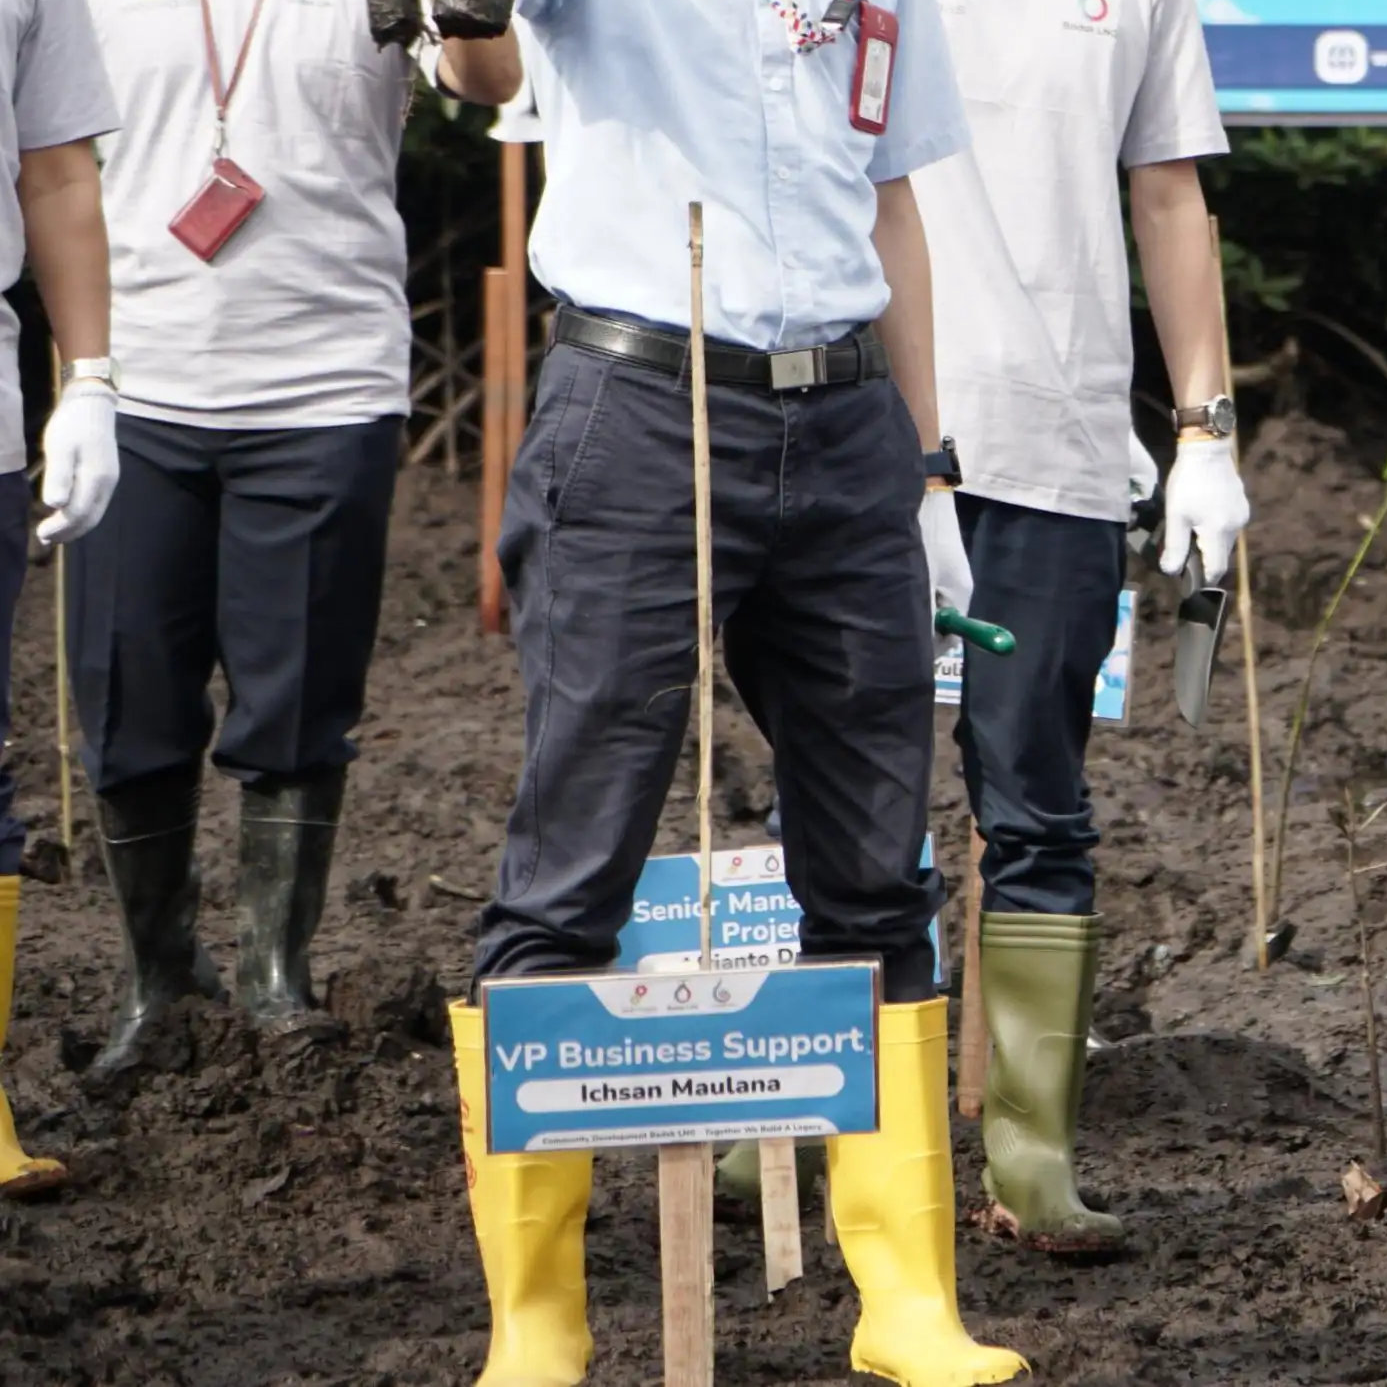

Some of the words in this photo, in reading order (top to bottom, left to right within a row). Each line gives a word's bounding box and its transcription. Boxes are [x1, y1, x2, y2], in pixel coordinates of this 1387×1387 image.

[496, 1042, 547, 1072] VP
[558, 1036, 711, 1069] Business
[722, 1027, 865, 1063] Support
[580, 1079, 662, 1103] Ichsan
[671, 1073, 781, 1098] Maulana
[591, 1131, 648, 1144] Development
